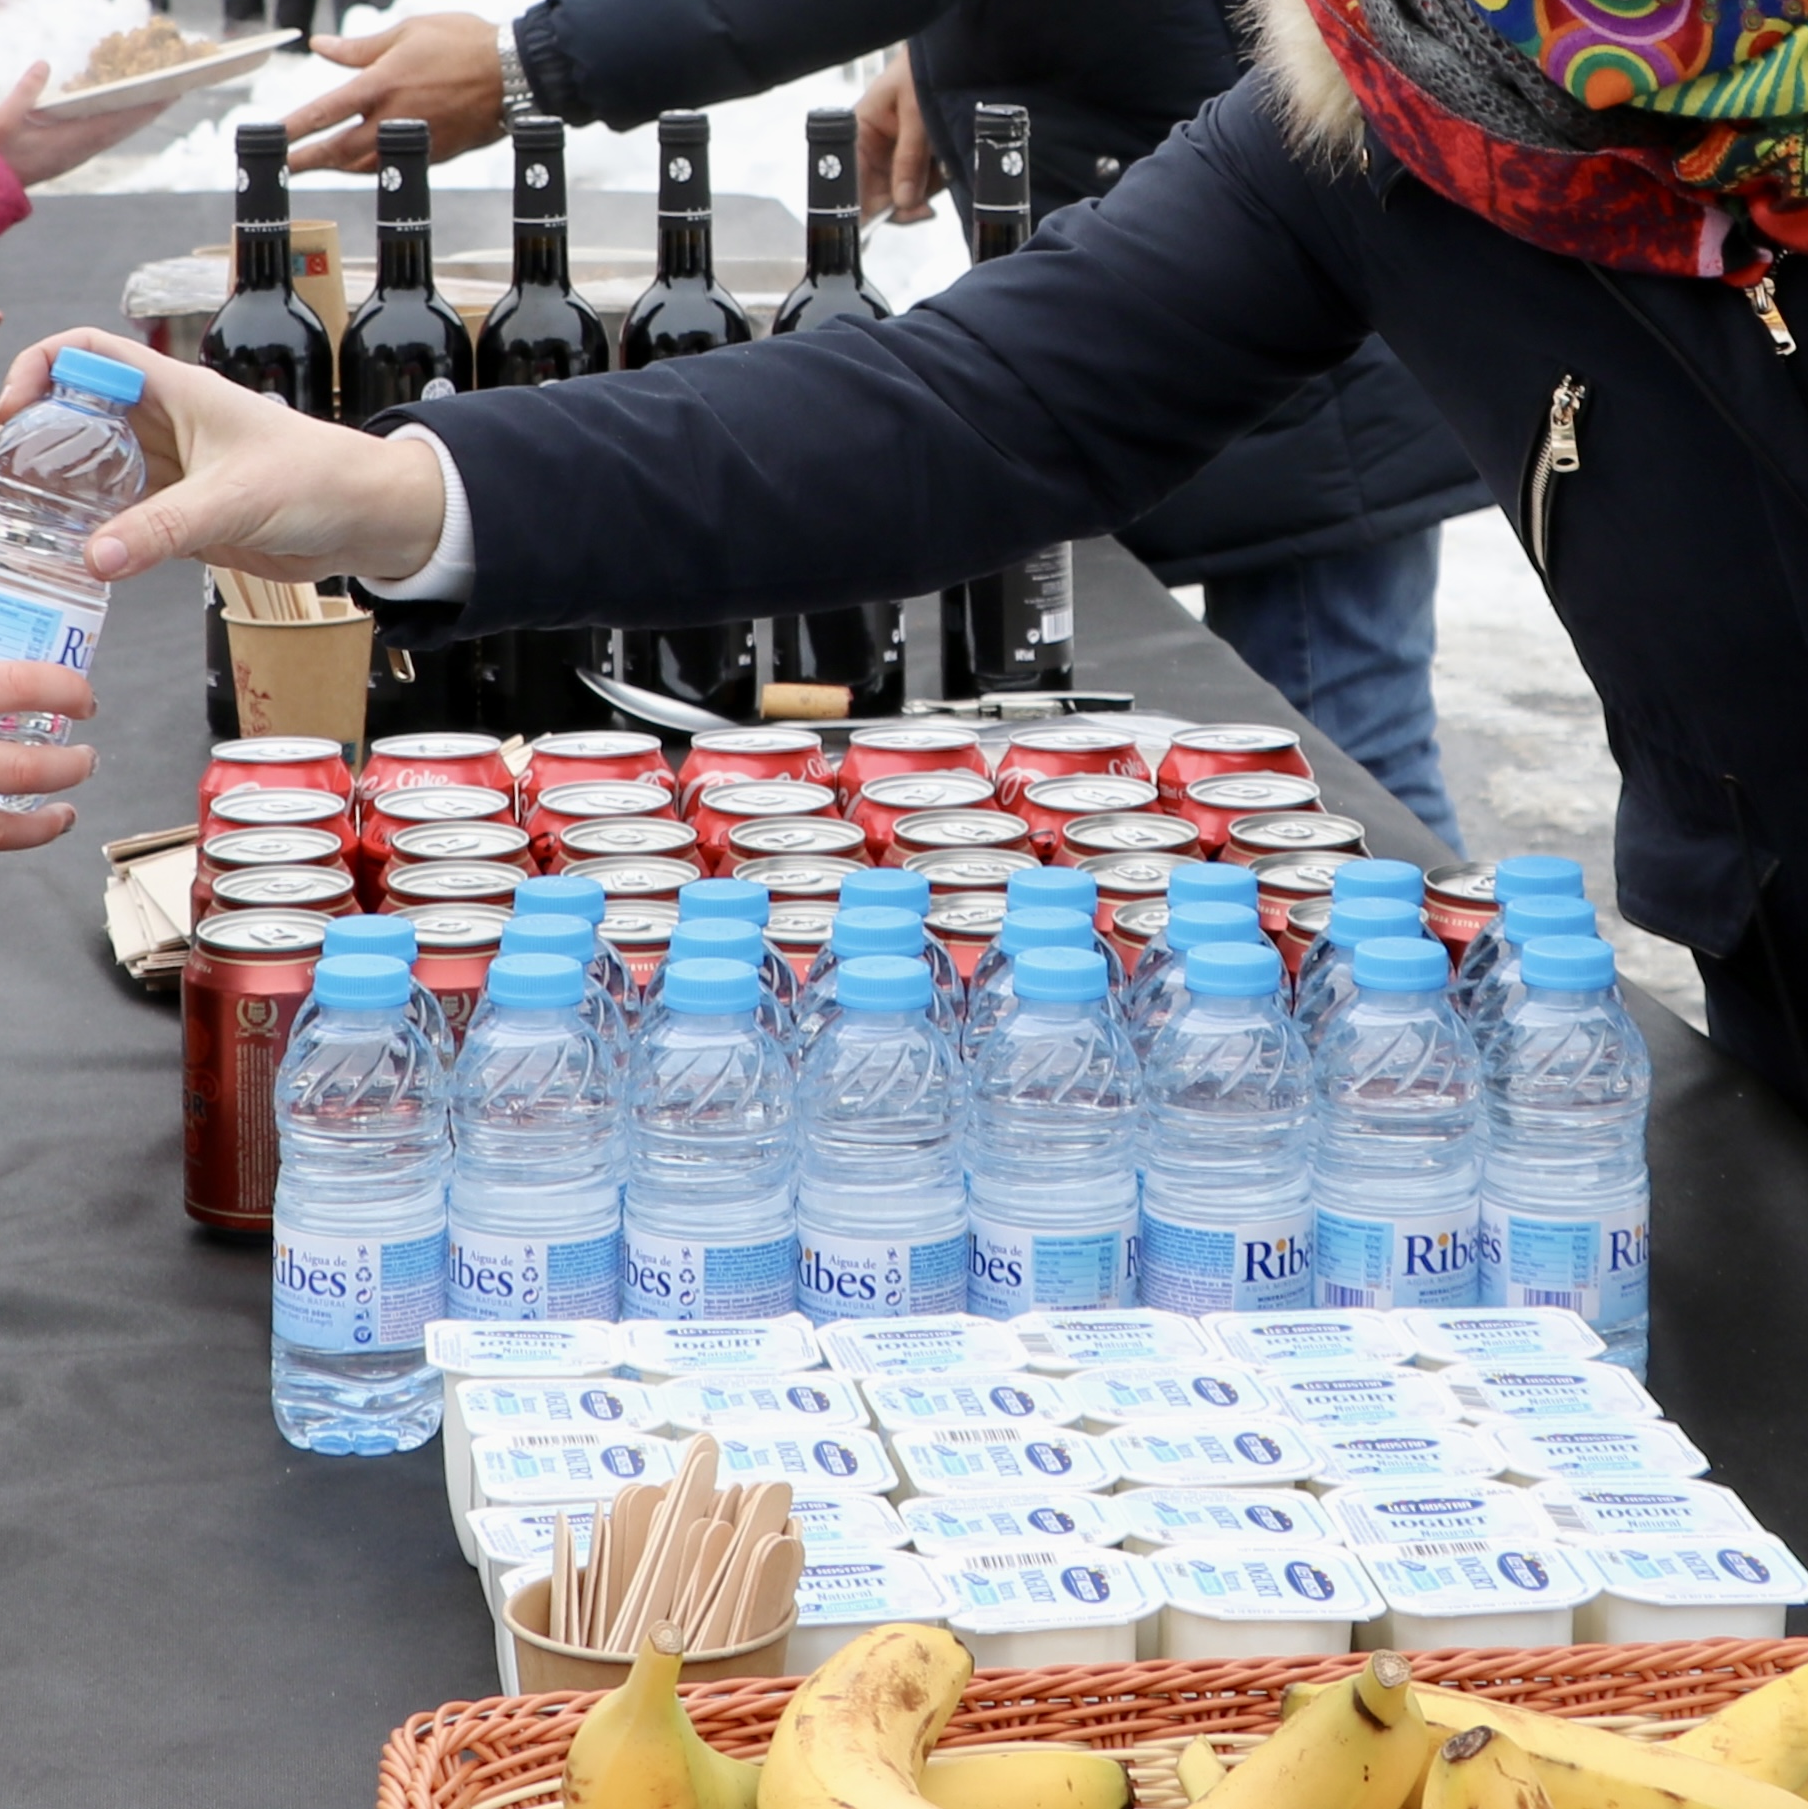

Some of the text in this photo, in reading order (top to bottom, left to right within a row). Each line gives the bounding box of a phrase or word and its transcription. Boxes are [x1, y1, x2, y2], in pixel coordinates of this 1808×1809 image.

[396, 768, 449, 788] Coke
[301, 1250, 348, 1268] Aigua de
[468, 1251, 514, 1268] Aigua de
[1010, 1246, 1023, 1258] de
[660, 1254, 672, 1268] de
[829, 1252, 877, 1271] Aigua de
[1596, 1506, 1694, 1521] IOGURT
[1389, 1514, 1490, 1531] IOGURT
[1626, 1517, 1682, 1532] Natural
[1419, 1526, 1477, 1541] Natural
[795, 1577, 888, 1592] OGURT
[816, 1589, 874, 1602] Natural
